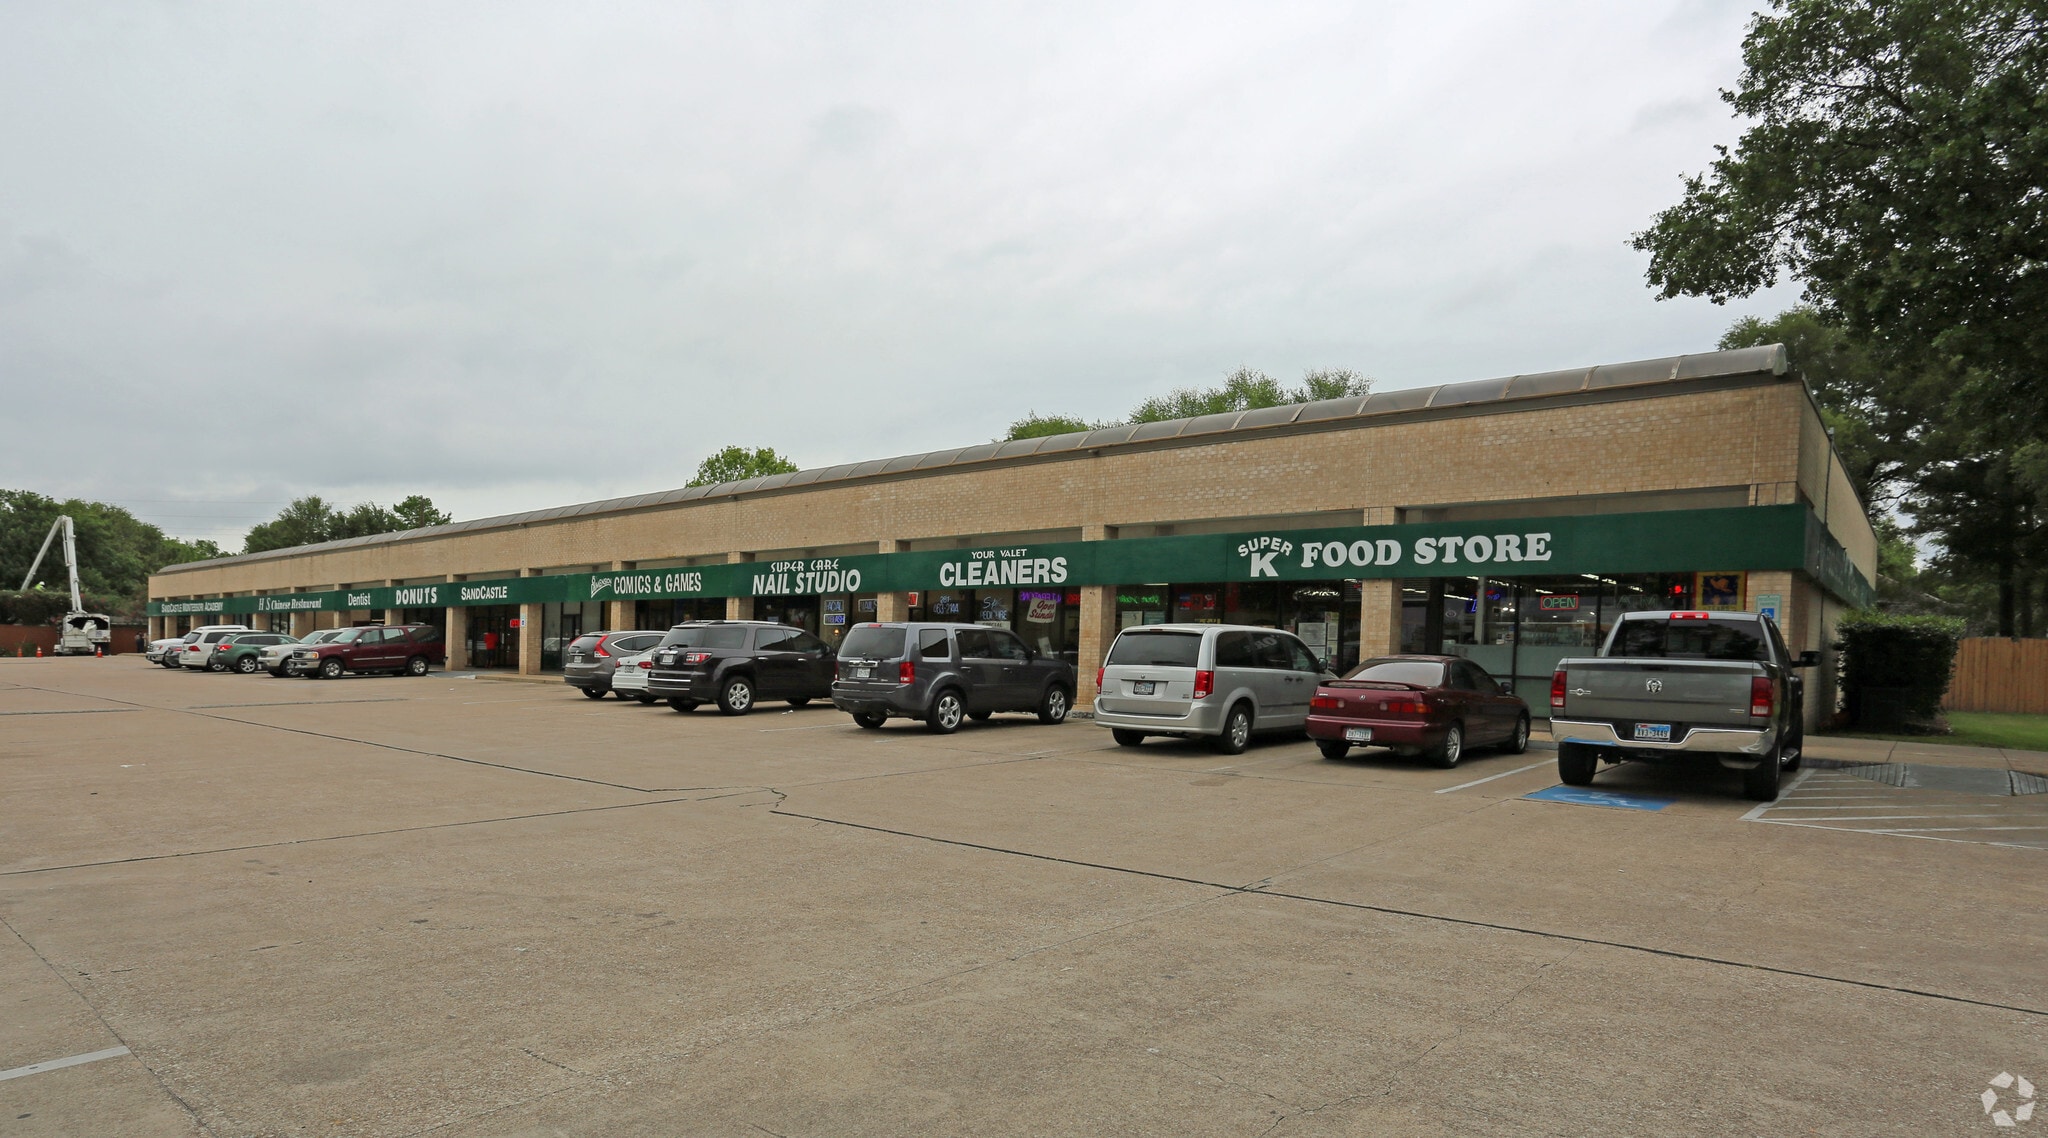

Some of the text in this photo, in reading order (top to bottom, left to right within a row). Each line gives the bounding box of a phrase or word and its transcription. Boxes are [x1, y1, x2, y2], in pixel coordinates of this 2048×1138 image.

[971, 549, 1027, 559] YOUR VALET
[1237, 536, 1293, 557] SUPER
[1250, 532, 1551, 578] K FOOD STORE
[770, 558, 839, 573] SUPER CARE
[939, 557, 1068, 587] CLEANERS
[614, 572, 701, 594] COMICS & GAMES
[752, 569, 861, 595] NAIL STUDIO
[348, 593, 371, 606] Dentist
[395, 587, 437, 605] DONUTS
[1542, 597, 1576, 609] OPEN
[204, 602, 223, 611] ACADEMY
[258, 598, 265, 611] H
[271, 600, 291, 610] Chinese
[291, 598, 322, 609] Restaurant
